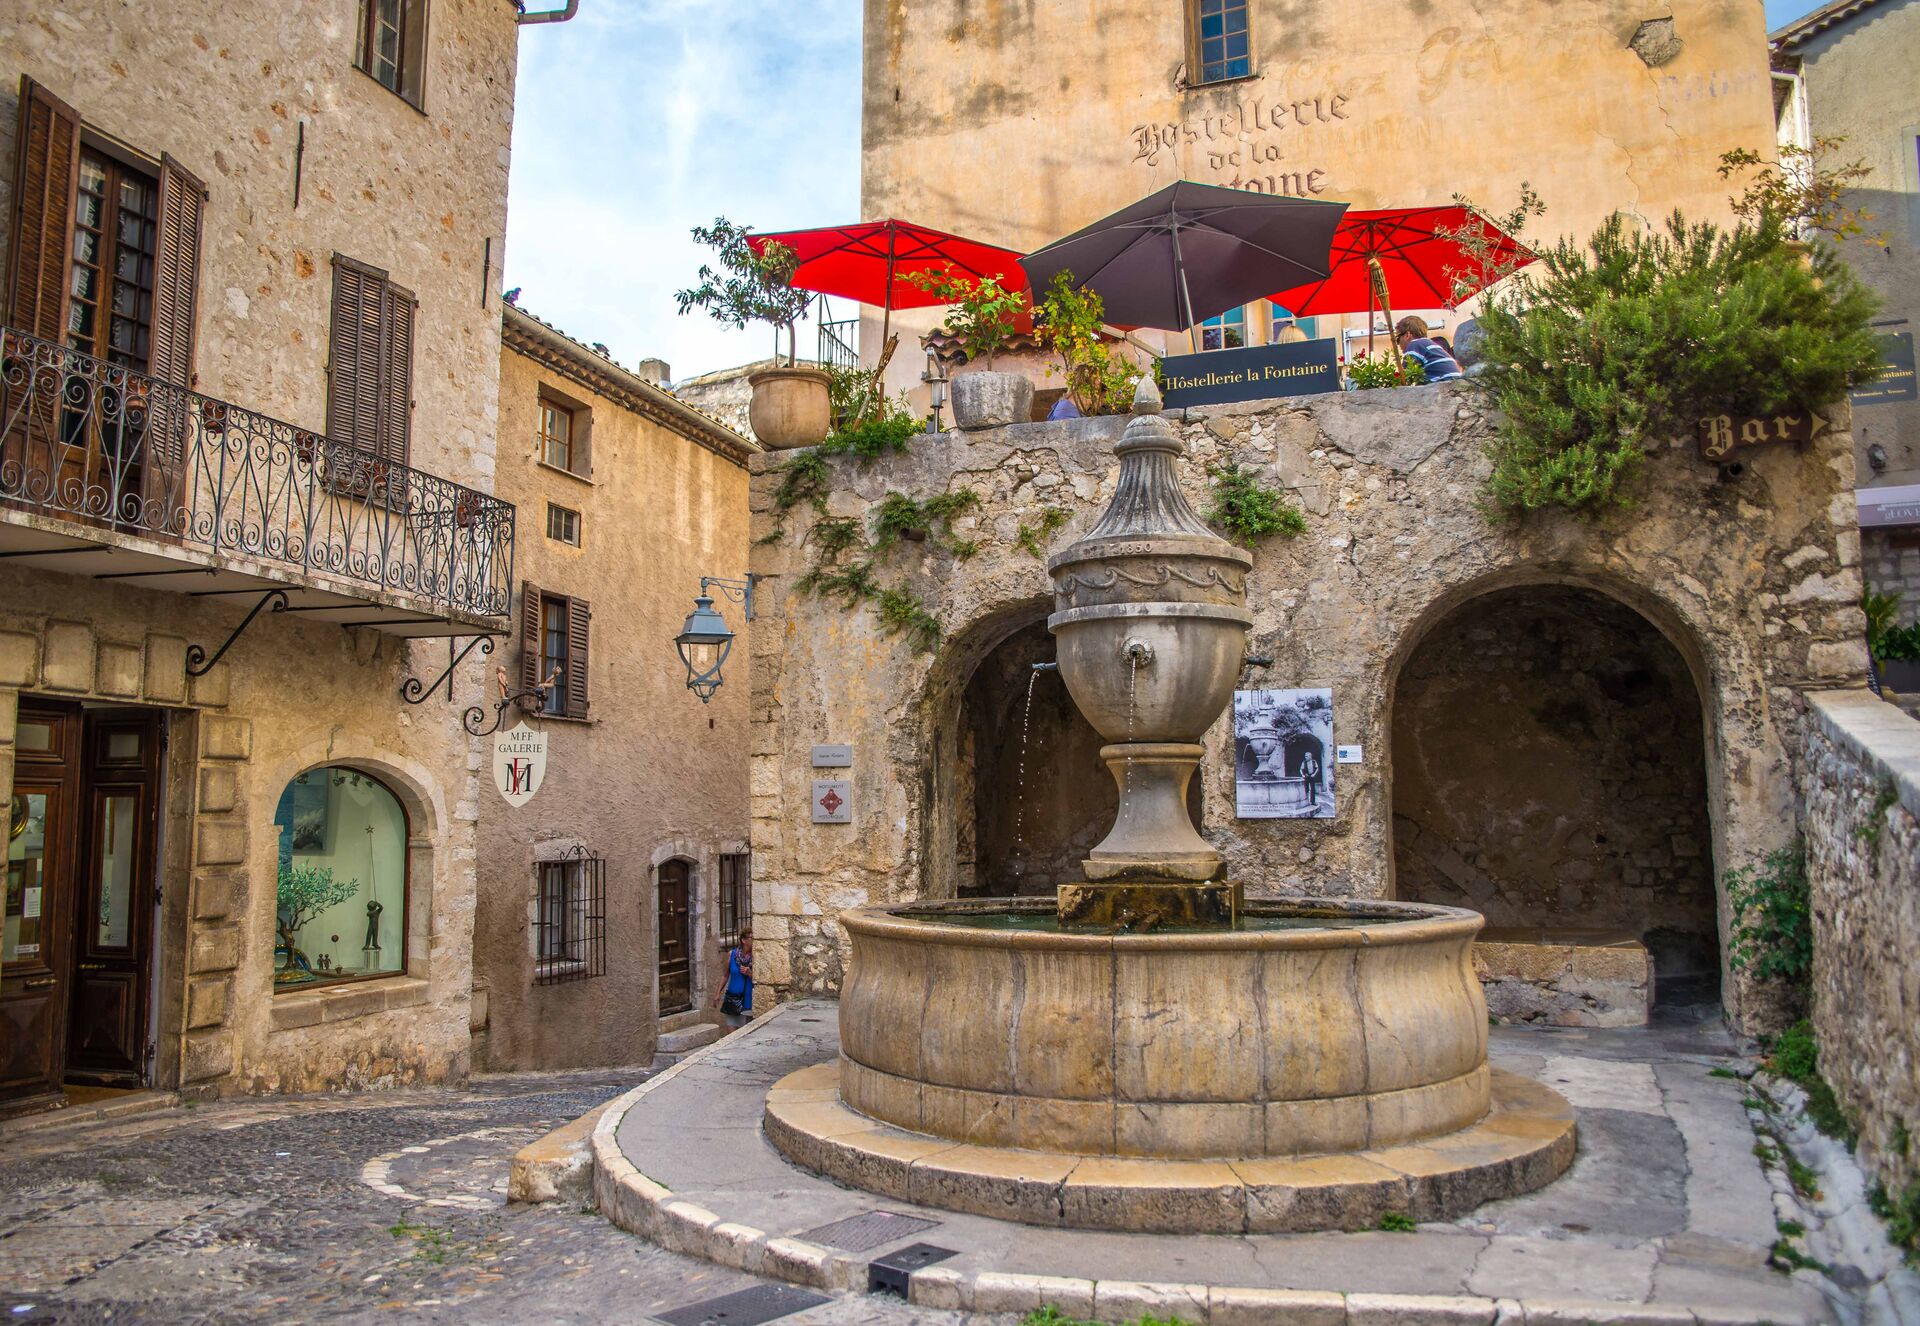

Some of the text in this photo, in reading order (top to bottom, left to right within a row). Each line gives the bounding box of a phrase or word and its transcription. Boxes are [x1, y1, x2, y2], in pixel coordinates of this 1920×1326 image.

[1131, 94, 1351, 167] Hostellerie
[1251, 142, 1285, 165] la
[1166, 362, 1328, 391] Hôstellerie la Fontaine
[1700, 414, 1800, 457] Bar
[498, 744, 543, 753] GALERIE
[510, 732, 534, 741] MFF
